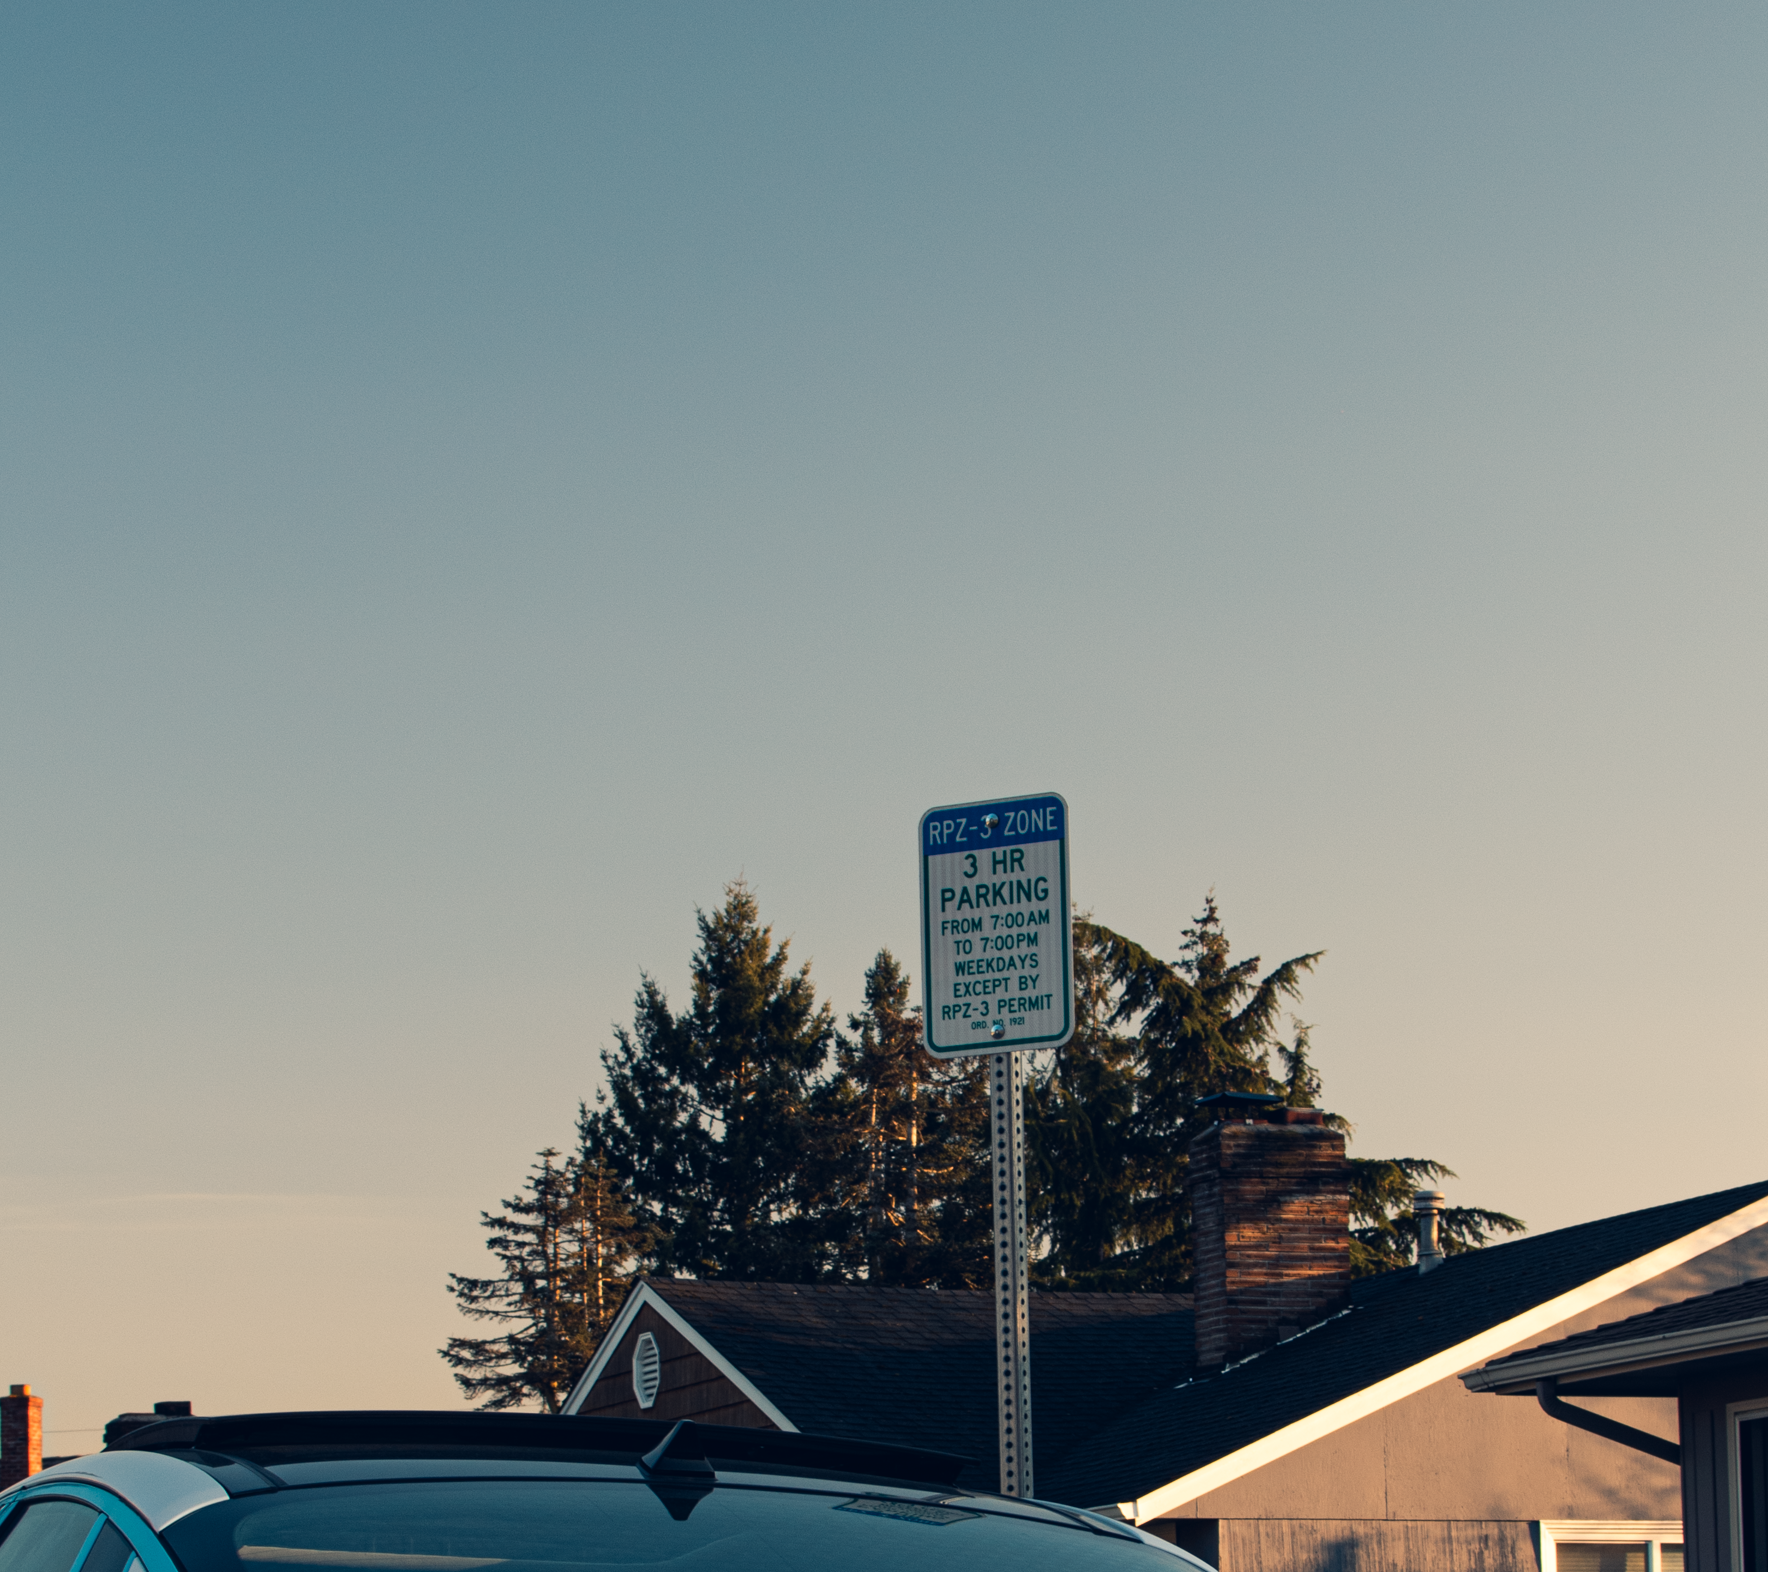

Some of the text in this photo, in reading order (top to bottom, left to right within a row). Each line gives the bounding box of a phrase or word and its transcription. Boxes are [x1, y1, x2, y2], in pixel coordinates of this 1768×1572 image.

[929, 807, 1058, 845] RPZ-3 ZONE
[963, 848, 1025, 878] 3 HR
[940, 876, 1050, 913] PARKING
[941, 916, 983, 936] FROM
[954, 932, 1039, 955] TO 7:00PM
[954, 953, 1039, 977] WEEKDAYS
[953, 973, 1040, 998] EXCEPT BY
[942, 994, 1053, 1020] RPZ-3 PERMIT
[971, 1020, 989, 1030] ORD.
[1009, 1016, 1025, 1026] 1921
